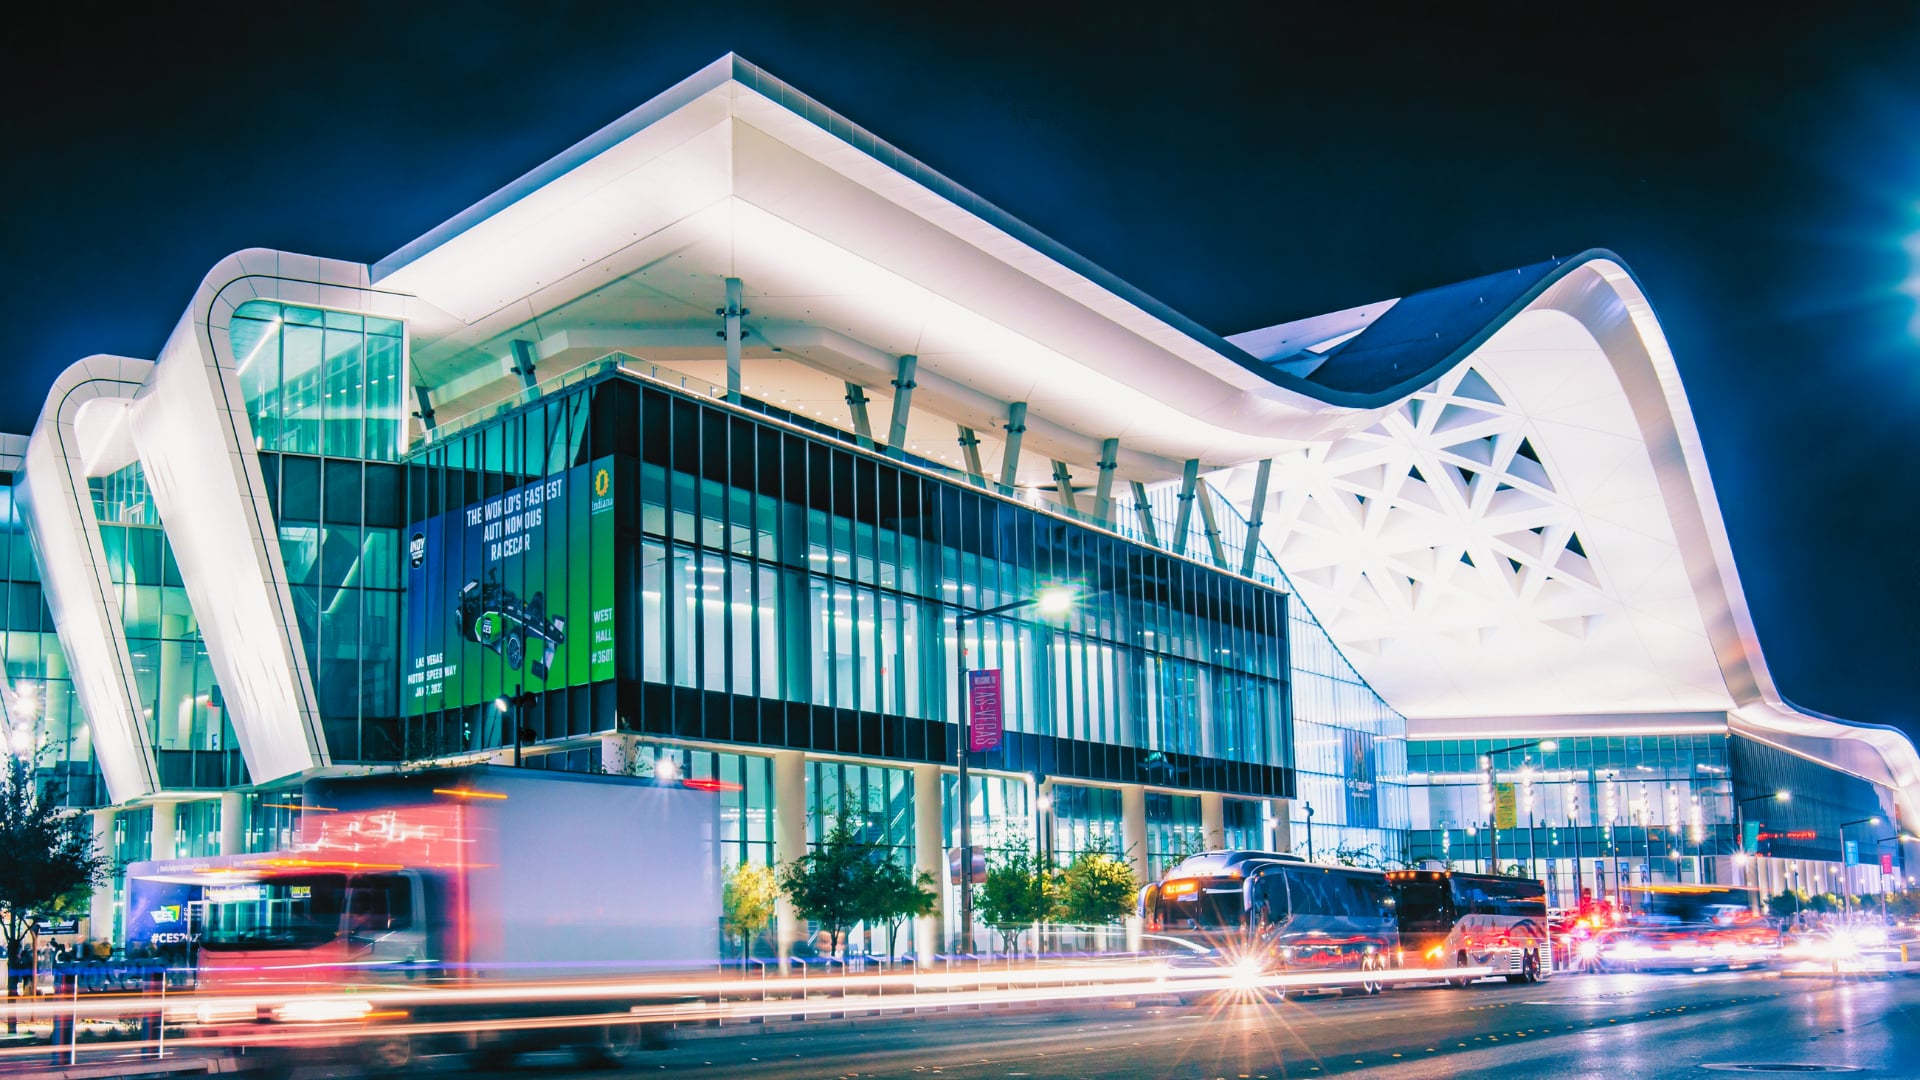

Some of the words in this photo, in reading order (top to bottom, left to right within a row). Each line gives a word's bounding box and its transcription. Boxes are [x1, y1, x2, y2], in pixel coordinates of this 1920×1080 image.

[467, 507, 482, 527] THE
[484, 493, 521, 521] WORLD'S
[524, 479, 562, 508] FASTEST
[592, 497, 613, 511] Indiana
[410, 537, 425, 552] INDY
[491, 534, 530, 561] RACECAR
[594, 608, 613, 624] WEST
[482, 624, 492, 634] CES
[596, 628, 612, 644] HALL
[415, 656, 425, 669] LAS
[426, 652, 443, 666] VEGAS
[150, 932, 202, 945] #CES202
